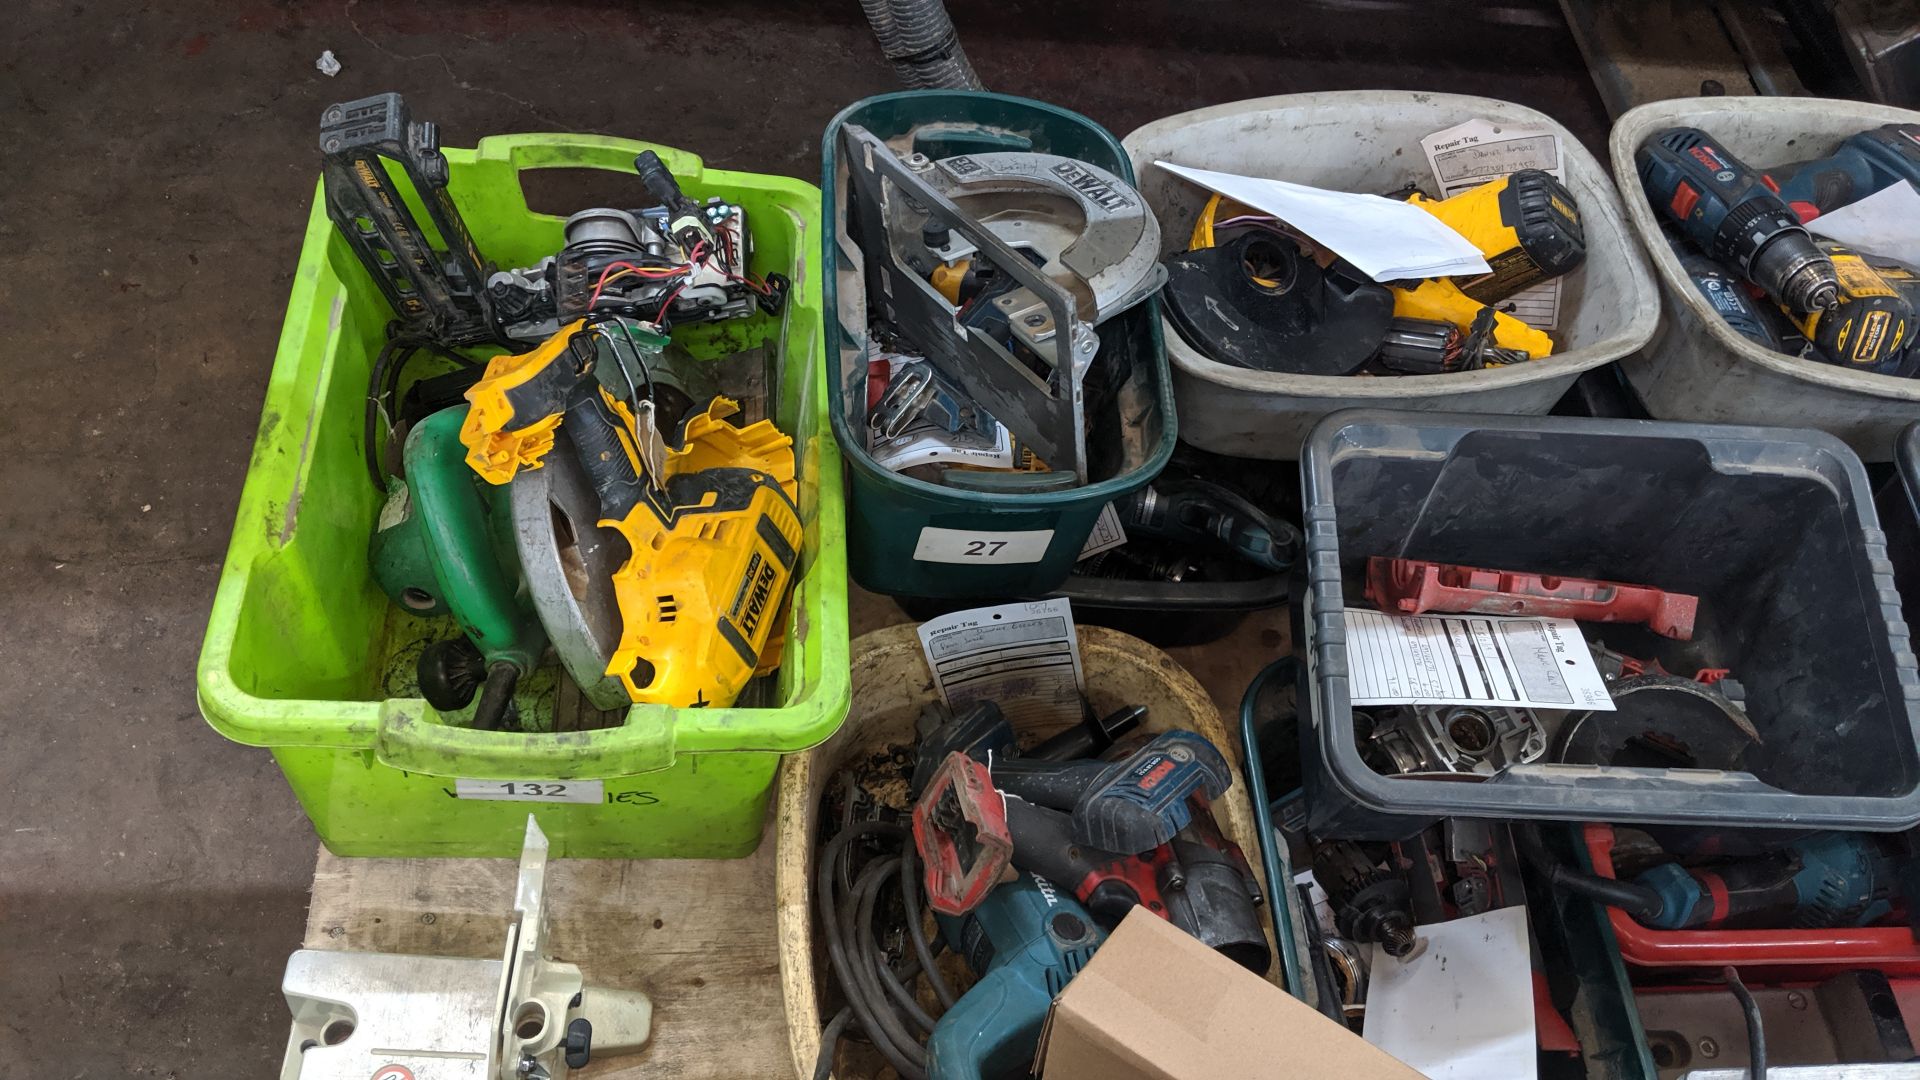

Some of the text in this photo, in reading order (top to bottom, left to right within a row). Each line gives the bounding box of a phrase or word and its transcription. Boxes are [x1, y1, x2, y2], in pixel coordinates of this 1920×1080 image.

[1434, 135, 1479, 151] Repair Tag
[1687, 146, 1722, 172] BOSCH
[355, 160, 381, 188] DEWALT
[1051, 160, 1136, 213] DEWALT
[963, 541, 1008, 556] 27
[742, 561, 776, 639] DEWALT
[930, 619, 979, 636] Repair Tag
[1546, 622, 1565, 653] Repair Tag
[500, 782, 567, 797] 132
[1030, 871, 1058, 907] kita
